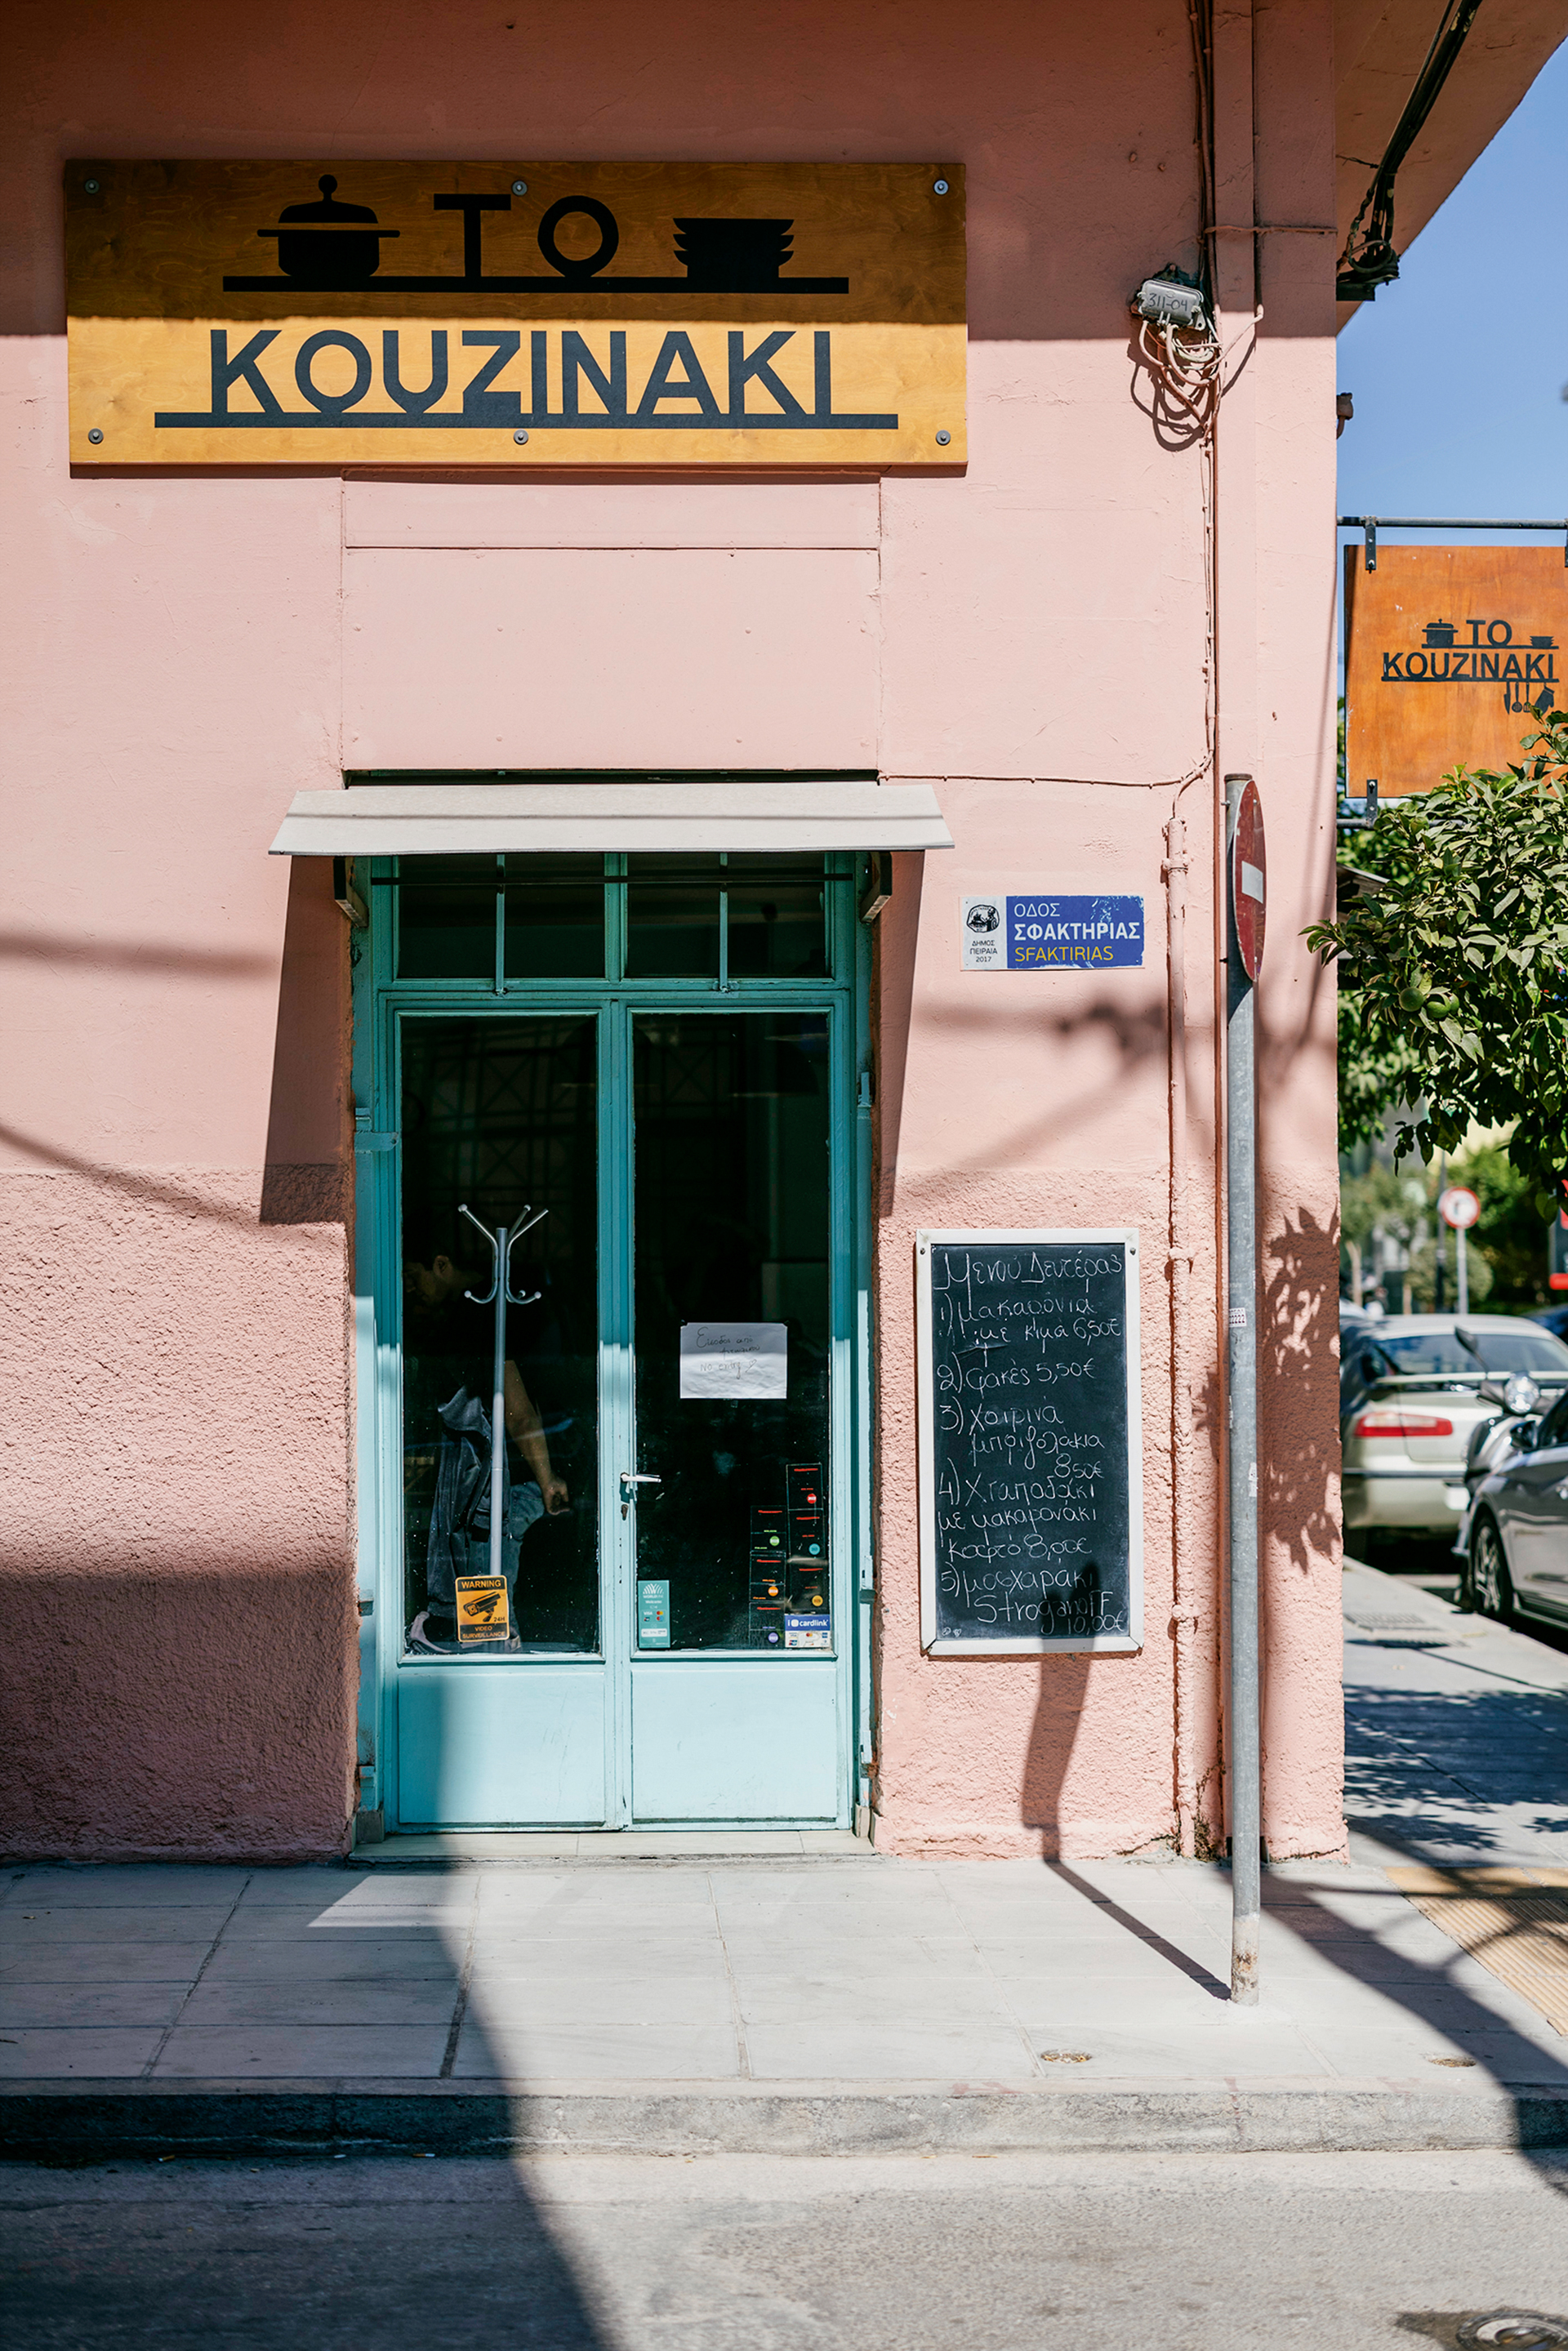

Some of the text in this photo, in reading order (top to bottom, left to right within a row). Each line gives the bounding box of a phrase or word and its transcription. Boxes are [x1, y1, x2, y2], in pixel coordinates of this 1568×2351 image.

[434, 193, 619, 279] TO
[1149, 292, 1187, 311] 311-04
[211, 328, 832, 416] KOUZINAKI
[1466, 620, 1512, 646] TO
[1383, 652, 1553, 679] KOUZINAKI
[1013, 903, 1060, 917] ΟΔΟΣ
[1013, 922, 1140, 941] ΣΦΑΚΤΗΡΙΑΣ
[969, 947, 998, 955] ΠΕΙΡΑΙΑ
[1014, 946, 1114, 962] SFAKTIRIAS
[1036, 1357, 1097, 1384] 5,50€
[938, 1511, 966, 1547] με
[1022, 1533, 1093, 1561] 8,00€
[461, 1579, 501, 1589] WARNING
[800, 1619, 828, 1627] cardlink
[461, 1632, 506, 1640] SURVEILLANCE
